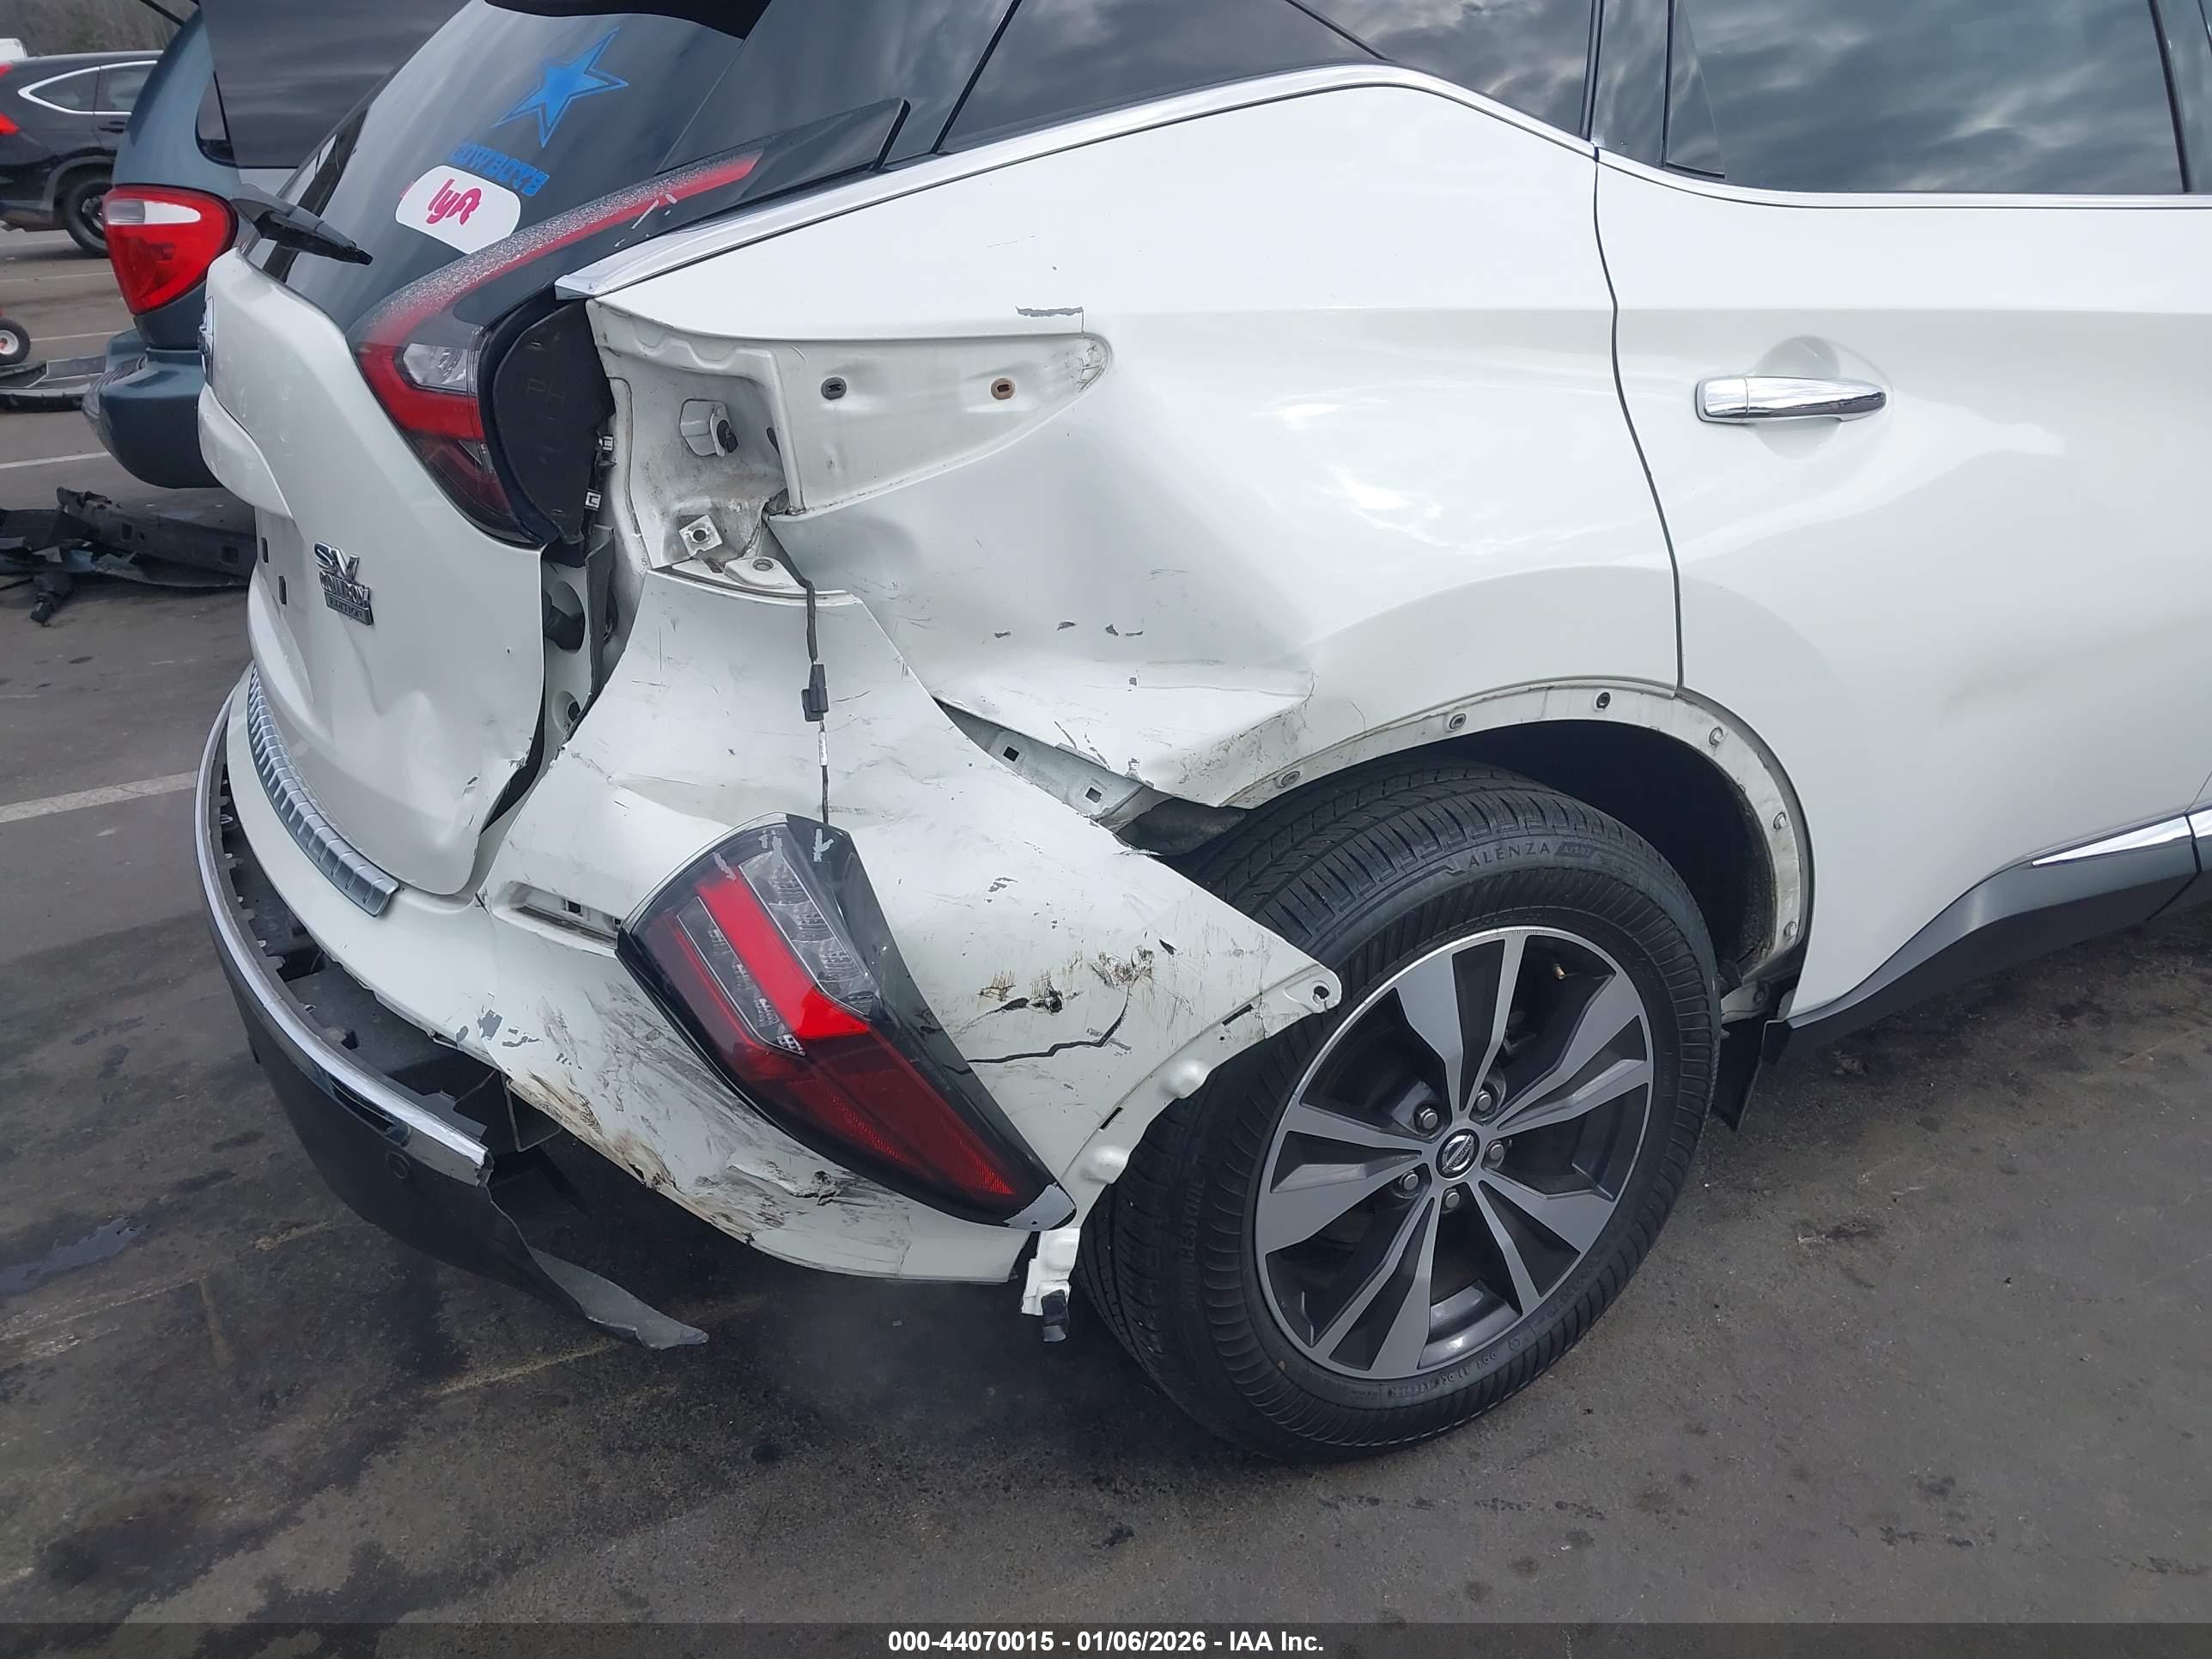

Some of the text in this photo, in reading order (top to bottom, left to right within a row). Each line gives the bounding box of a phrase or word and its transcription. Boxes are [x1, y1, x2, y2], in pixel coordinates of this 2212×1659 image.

[448, 141, 550, 198] COWBOYS
[313, 541, 361, 582] SV
[1468, 842, 1552, 869] ALENZA
